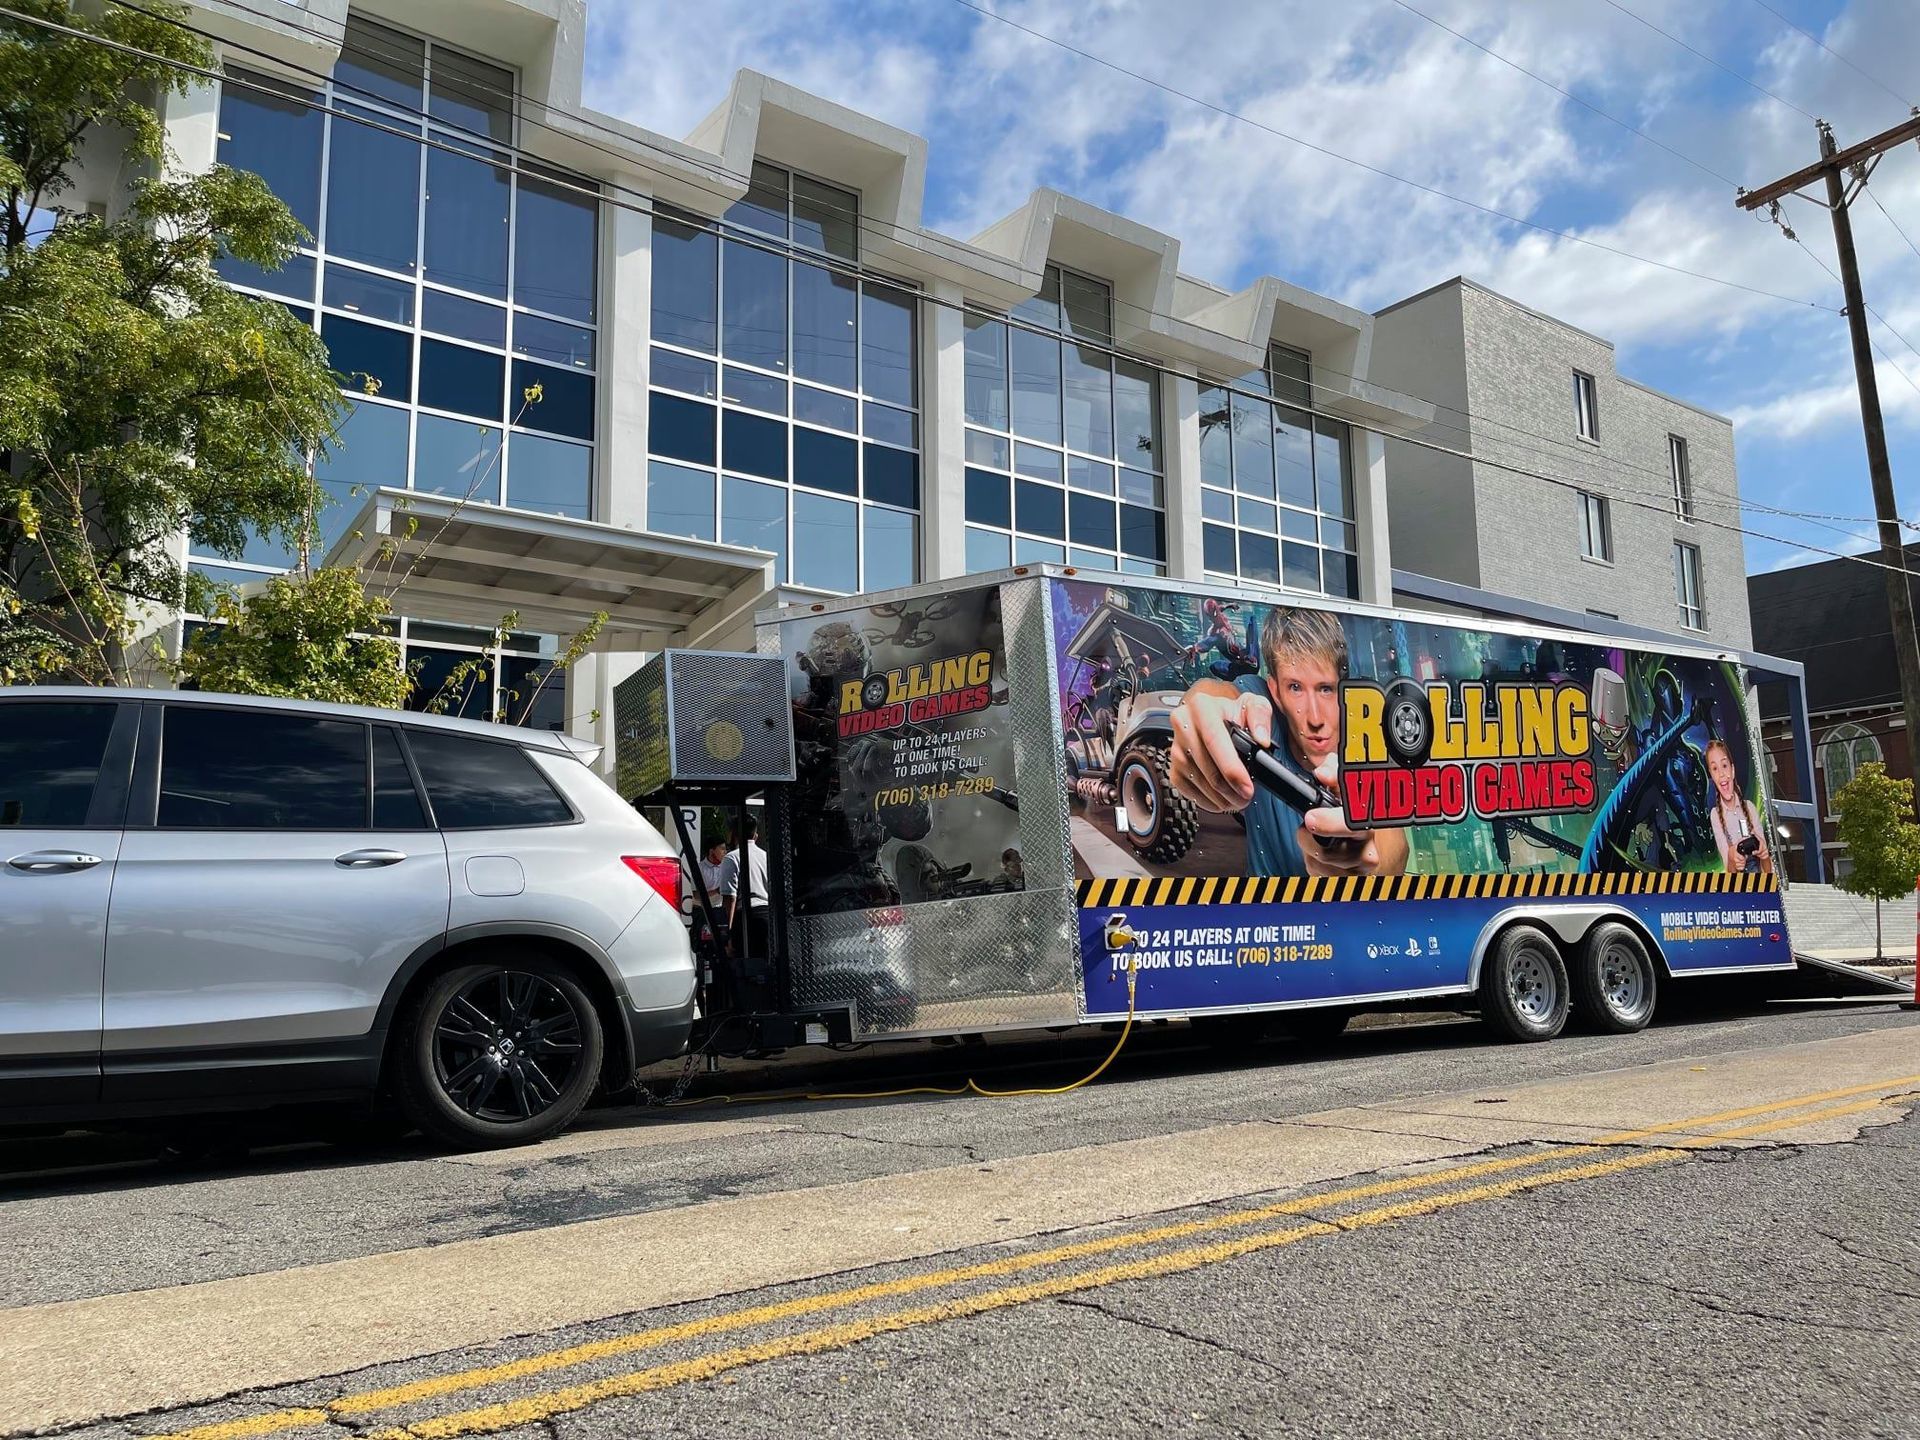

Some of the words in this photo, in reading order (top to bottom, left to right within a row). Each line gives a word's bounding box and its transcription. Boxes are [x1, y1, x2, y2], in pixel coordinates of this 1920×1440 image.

[839, 652, 991, 715] ROLLING
[838, 703, 905, 738] VIDEO
[909, 686, 990, 723] GAMES
[1343, 680, 1590, 768] ROLLING
[892, 739, 906, 751] UP
[910, 736, 922, 748] TO
[924, 735, 938, 747] 24
[941, 727, 987, 744] PLAYERS
[892, 753, 906, 765] AT
[909, 749, 929, 763] ONE
[933, 744, 961, 759] TIME!
[894, 766, 907, 778] TO
[910, 761, 939, 776] BOOK
[941, 759, 956, 771] US
[958, 755, 988, 770] CALL:
[874, 786, 914, 810] (706)
[919, 776, 995, 801] 318-7289
[1344, 763, 1465, 822] VIDEO
[1474, 760, 1595, 814] GAMES
[1660, 912, 1694, 927] MOBILE
[1694, 911, 1720, 926] VIDEO
[1721, 910, 1744, 925] GAME
[1745, 910, 1780, 925] THEATER
[1151, 930, 1170, 947] 24
[1173, 928, 1232, 947] PLAYERS
[1235, 927, 1250, 944] AT
[1253, 926, 1279, 943] ONE
[1282, 925, 1315, 941] TIME!
[1663, 926, 1762, 942] RollingVideoGames.com
[1111, 952, 1130, 971] TO
[1134, 950, 1171, 969] BOOK
[1174, 950, 1193, 967] US
[1196, 949, 1233, 966] CALL:
[1236, 947, 1270, 968] (706)
[1273, 944, 1333, 963] 318-7289
